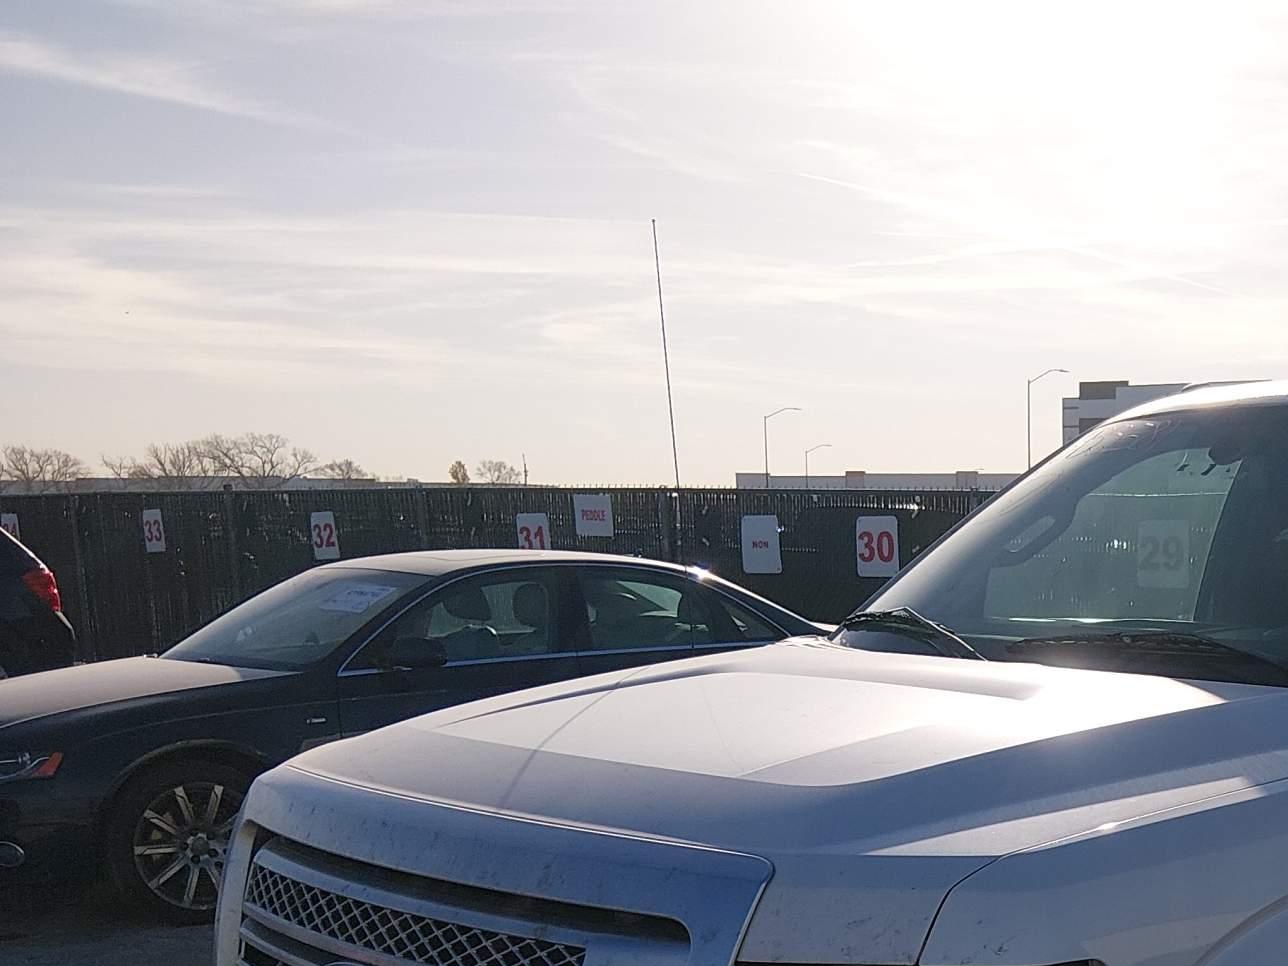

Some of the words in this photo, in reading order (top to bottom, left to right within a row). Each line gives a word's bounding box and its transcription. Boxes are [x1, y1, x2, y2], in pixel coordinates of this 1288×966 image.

[144, 519, 162, 542] 33
[313, 523, 336, 548] 32
[519, 526, 545, 550] 31
[752, 540, 769, 549] NON
[858, 531, 895, 562] 30
[1139, 536, 1183, 571] 29
